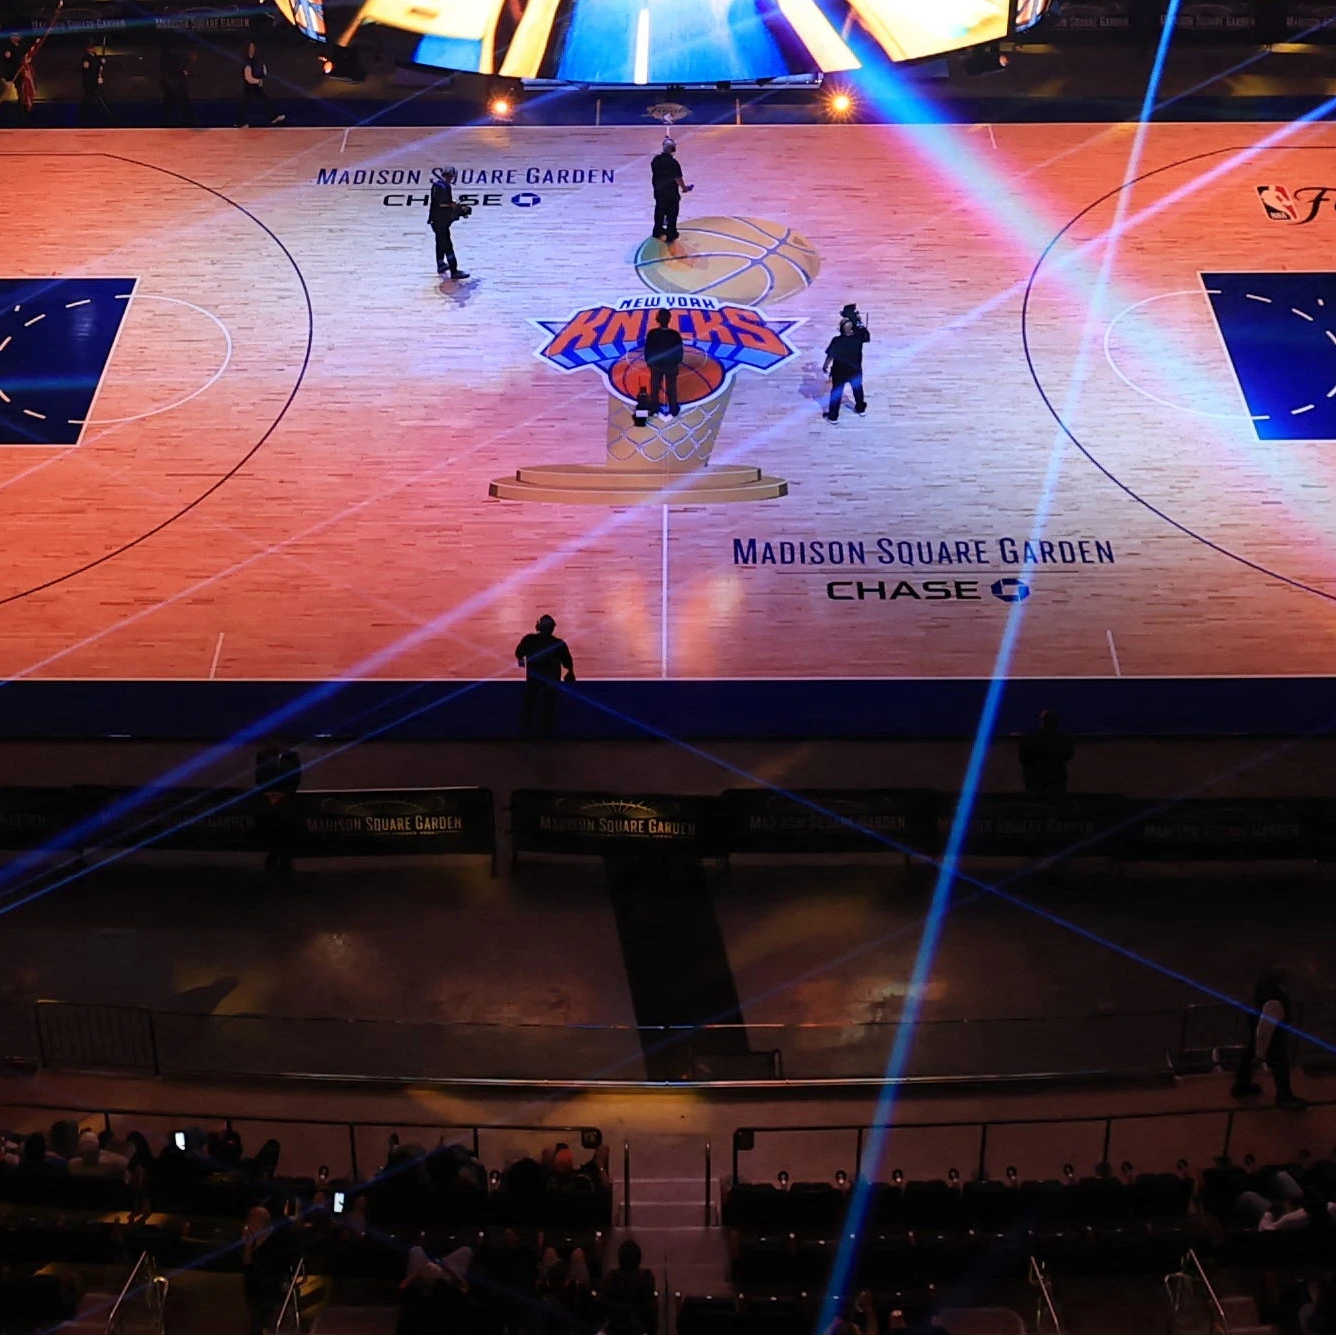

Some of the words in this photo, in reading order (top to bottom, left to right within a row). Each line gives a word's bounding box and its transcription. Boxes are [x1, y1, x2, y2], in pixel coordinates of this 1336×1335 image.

[316, 168, 421, 185] MADISON
[526, 167, 615, 184] GARDEN
[383, 194, 503, 207] CHSE
[619, 296, 661, 310] NEW
[666, 295, 715, 309] YORK
[733, 538, 865, 564] MADISON
[877, 538, 989, 566] SQUARE
[1000, 537, 1116, 564] GARDEN
[827, 581, 979, 600] CHASE
[365, 816, 411, 832] SQUARE
[415, 815, 462, 831] GARDEN
[599, 817, 645, 833] SQUARE
